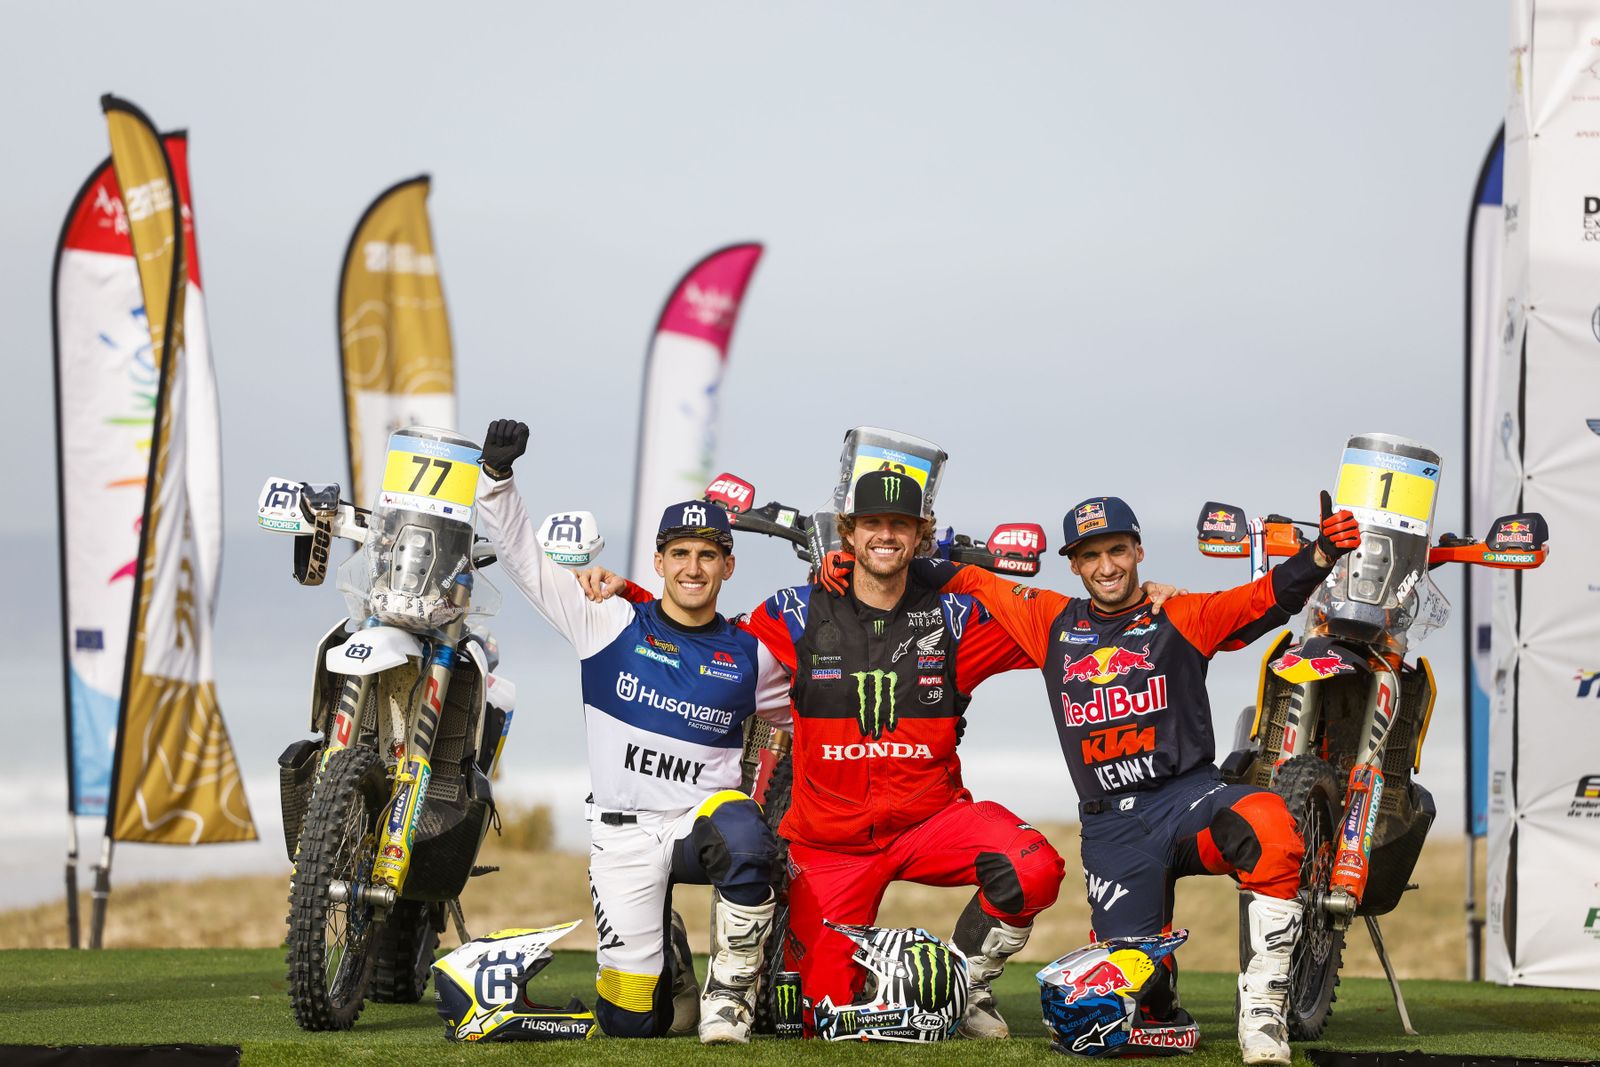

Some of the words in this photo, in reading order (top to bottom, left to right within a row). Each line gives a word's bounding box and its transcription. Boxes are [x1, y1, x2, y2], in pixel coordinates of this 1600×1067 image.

[408, 456, 452, 495] 77
[1422, 467, 1437, 476] 47
[1380, 472, 1393, 508] 1
[262, 517, 297, 529] MOTOREX
[1203, 521, 1219, 531] Red
[1219, 522, 1237, 532] Bull
[1496, 532, 1515, 543] Red
[1515, 532, 1533, 543] Bull
[308, 520, 332, 580] 100%
[1205, 543, 1241, 552] MOTOREX
[552, 553, 588, 563] MOTOREX
[997, 558, 1034, 571] MOTUL
[1495, 554, 1533, 563] MOTOREX
[919, 677, 942, 685] MOTUL
[638, 685, 734, 726] Husqvarna
[1061, 687, 1106, 727] Red
[1106, 675, 1168, 720] Bull
[687, 721, 713, 733] FACTORY
[822, 742, 934, 761] HONDA
[1081, 723, 1157, 765] KTM
[624, 743, 706, 785] KENNY
[1094, 755, 1157, 791] KENNY
[412, 768, 431, 828] MOTOREX
[1366, 777, 1384, 836] MOTOREX
[521, 1017, 586, 1034] Husqvarna
[856, 1012, 902, 1024] MONSTER
[914, 1015, 941, 1026] Arai
[1128, 1028, 1164, 1046] Red
[1164, 1028, 1197, 1048] Bull
